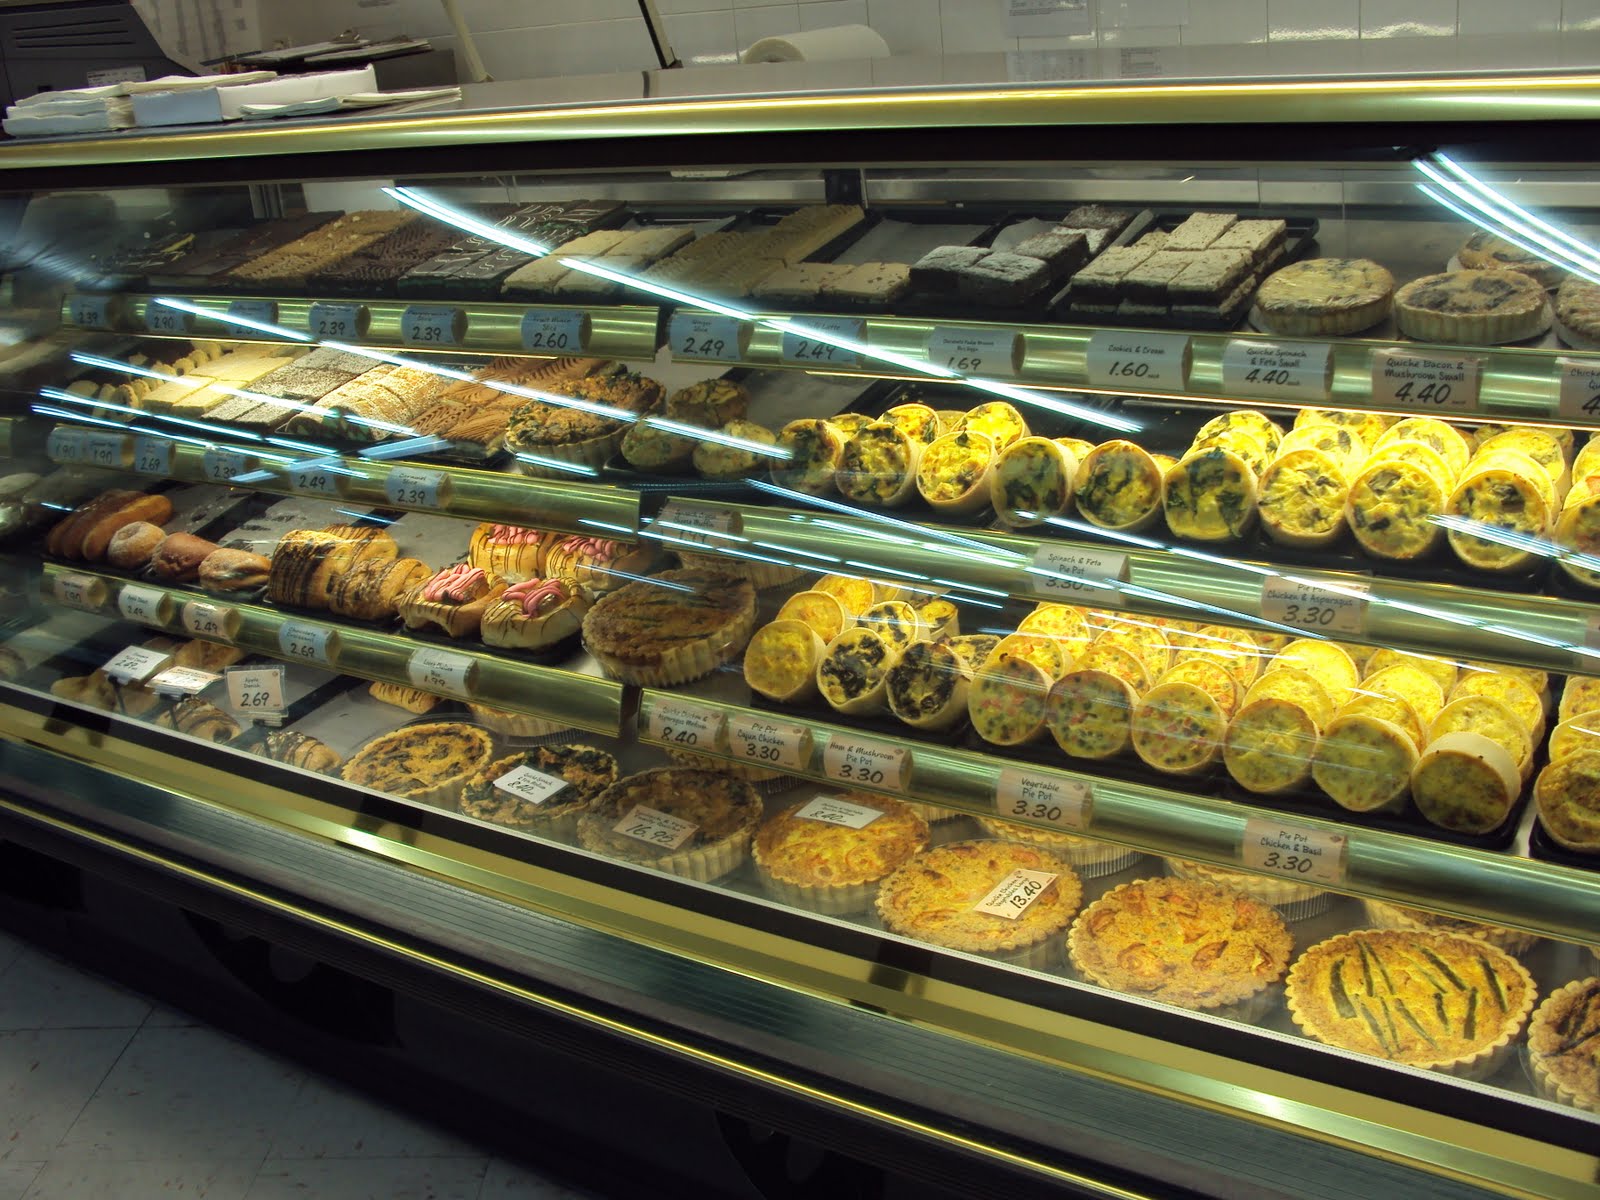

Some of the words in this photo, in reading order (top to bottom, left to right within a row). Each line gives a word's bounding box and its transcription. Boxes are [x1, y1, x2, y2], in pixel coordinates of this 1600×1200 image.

[319, 321, 346, 335] 2.39
[411, 326, 442, 342] 2.39
[532, 332, 568, 349] 2.60
[683, 337, 725, 357] 2.49
[1108, 344, 1132, 353] Cookies
[1135, 345, 1141, 353] &
[1246, 348, 1274, 357] Quiche
[1276, 349, 1307, 358] Spinach
[947, 357, 982, 371] 1.69
[1109, 361, 1149, 377] 1.60
[1386, 358, 1421, 368] Quiche
[1423, 359, 1453, 369] Bacon
[1456, 361, 1464, 370] &
[1245, 368, 1289, 385] 4.40
[1384, 368, 1436, 380] Mushroom
[1439, 371, 1465, 382] Small
[1395, 381, 1451, 404] 4.40
[140, 457, 160, 471] 2.69
[299, 474, 326, 490] 2.49
[397, 489, 426, 504] 2.39
[1048, 553, 1075, 563] Spinach
[1086, 558, 1102, 566] Feta
[1059, 564, 1070, 573] Pie
[1071, 566, 1085, 575] Pot
[1267, 590, 1298, 600] Chicken
[1310, 593, 1353, 608] Asparagus
[1282, 605, 1336, 626] 3.30
[194, 619, 218, 634] 2.49
[290, 642, 315, 658] 2.69
[424, 675, 446, 687] 1.99
[240, 691, 270, 707] 2.69
[661, 726, 697, 745] 8.40
[751, 722, 763, 731] Pie
[764, 725, 778, 734] Pot
[737, 728, 757, 742] Cajun
[758, 733, 785, 747] Chicken
[746, 743, 780, 761] 3.30
[829, 742, 845, 751] Ham
[847, 745, 854, 753] &
[856, 747, 894, 761] Mushroom
[845, 753, 858, 762] Pie
[860, 756, 873, 766] Pot
[839, 764, 884, 784] 3.30
[1021, 777, 1060, 792] Vegetable
[1022, 787, 1036, 798] Pie
[1037, 790, 1053, 801] Pot
[1012, 800, 1062, 821] 3.30
[1279, 830, 1292, 840] Pie
[1293, 833, 1308, 843] Pot
[1260, 837, 1291, 851] Chicken
[1293, 844, 1300, 852] &
[1302, 845, 1322, 856] Basil
[1264, 852, 1312, 873] 3.30
[1009, 880, 1042, 909] 13.40
